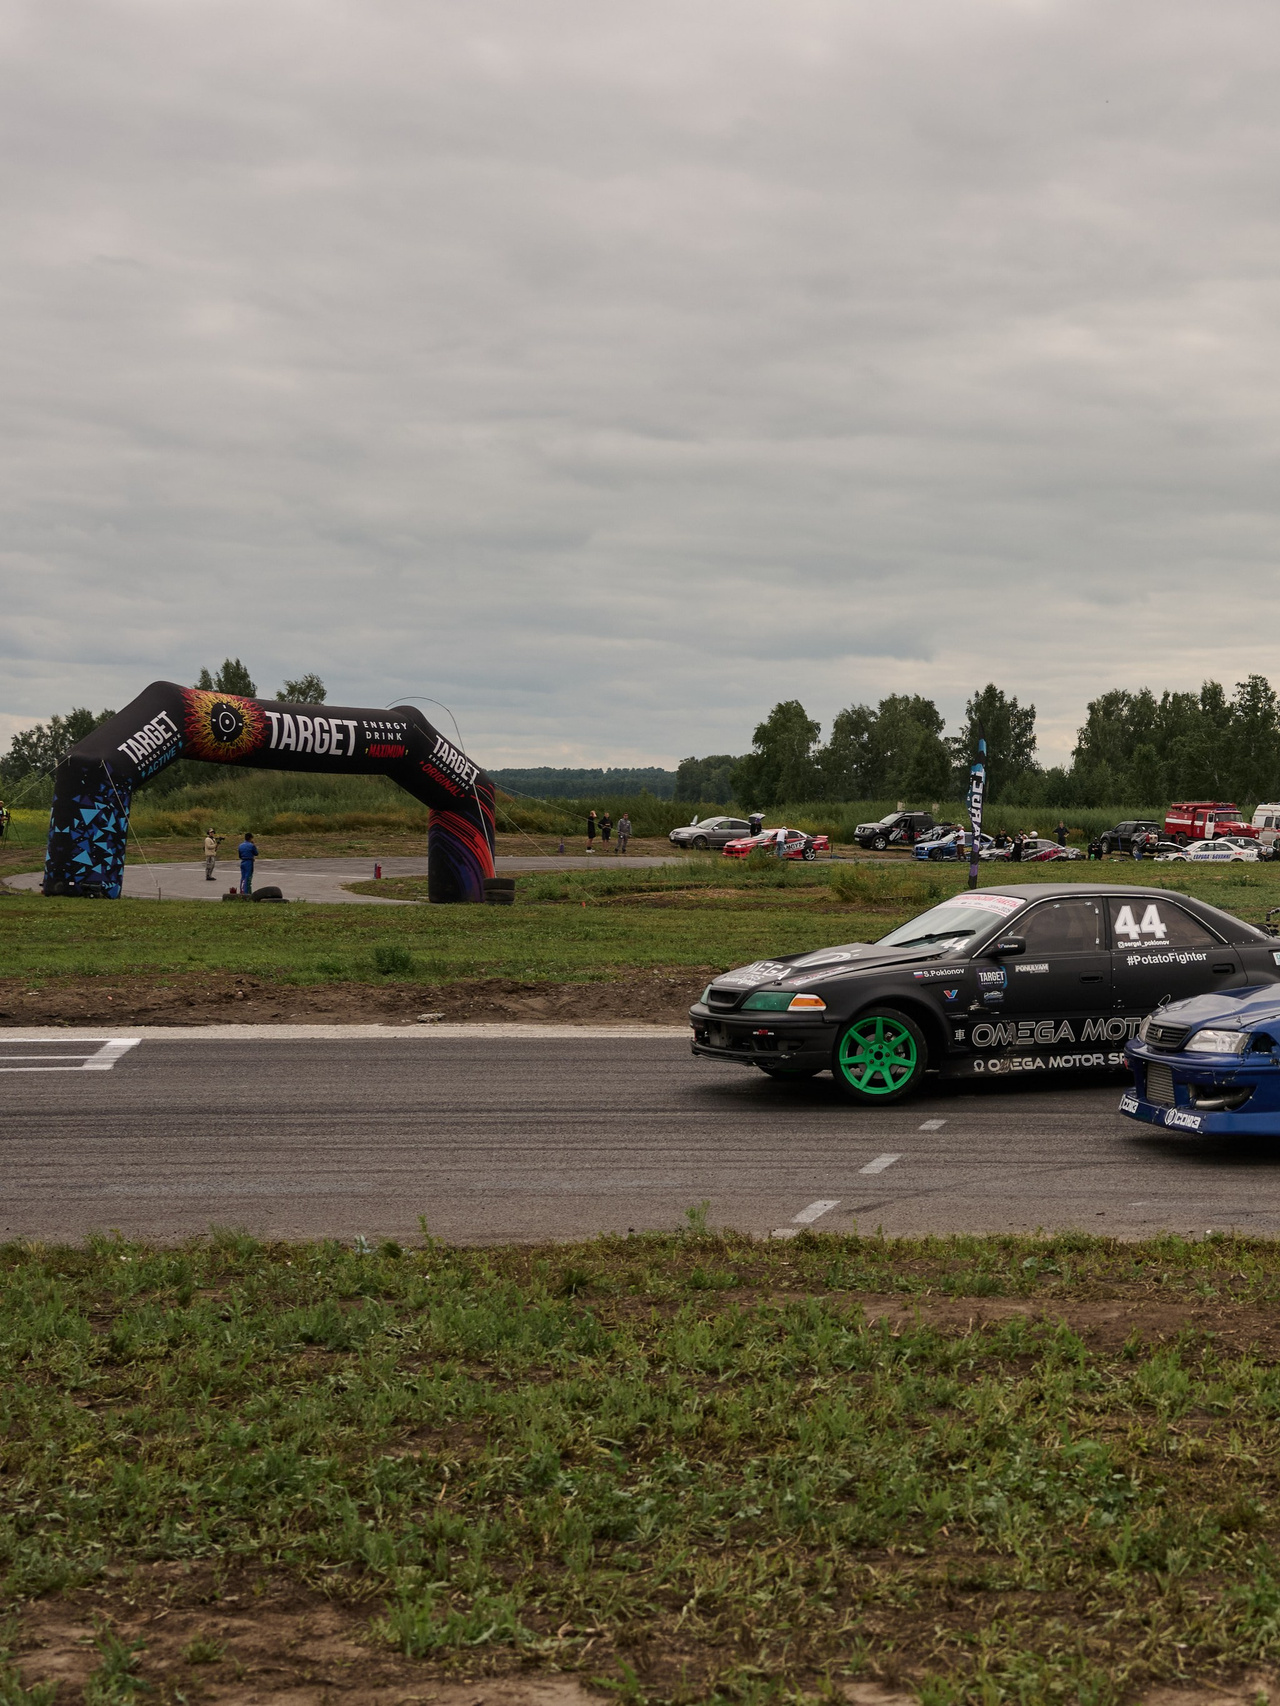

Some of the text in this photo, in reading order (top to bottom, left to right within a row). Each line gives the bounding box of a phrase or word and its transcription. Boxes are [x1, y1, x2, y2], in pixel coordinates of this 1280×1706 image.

[264, 710, 358, 756] TARGET
[362, 720, 408, 730] ENERGY
[117, 710, 178, 764] TARGET
[366, 731, 402, 741] DRINK
[138, 733, 182, 770] ENERGY DRINK
[368, 744, 405, 758] MAXIMUM
[432, 734, 480, 785] TARGET
[147, 746, 177, 776] ACTIVE
[422, 763, 461, 797] ORIGINAL
[428, 754, 470, 790] ENERGY DRINK
[1114, 904, 1168, 940] 44
[940, 938, 970, 951] 44
[1126, 952, 1207, 966] #PotatoFighter
[923, 968, 965, 978] S.Poklonov
[978, 971, 1004, 982] TARGET
[954, 1029, 966, 1042] 車
[972, 1017, 1142, 1047] OMEGA MOT
[1048, 1053, 1105, 1068] MOTOR
[1175, 1113, 1201, 1130] СОЮЗ
